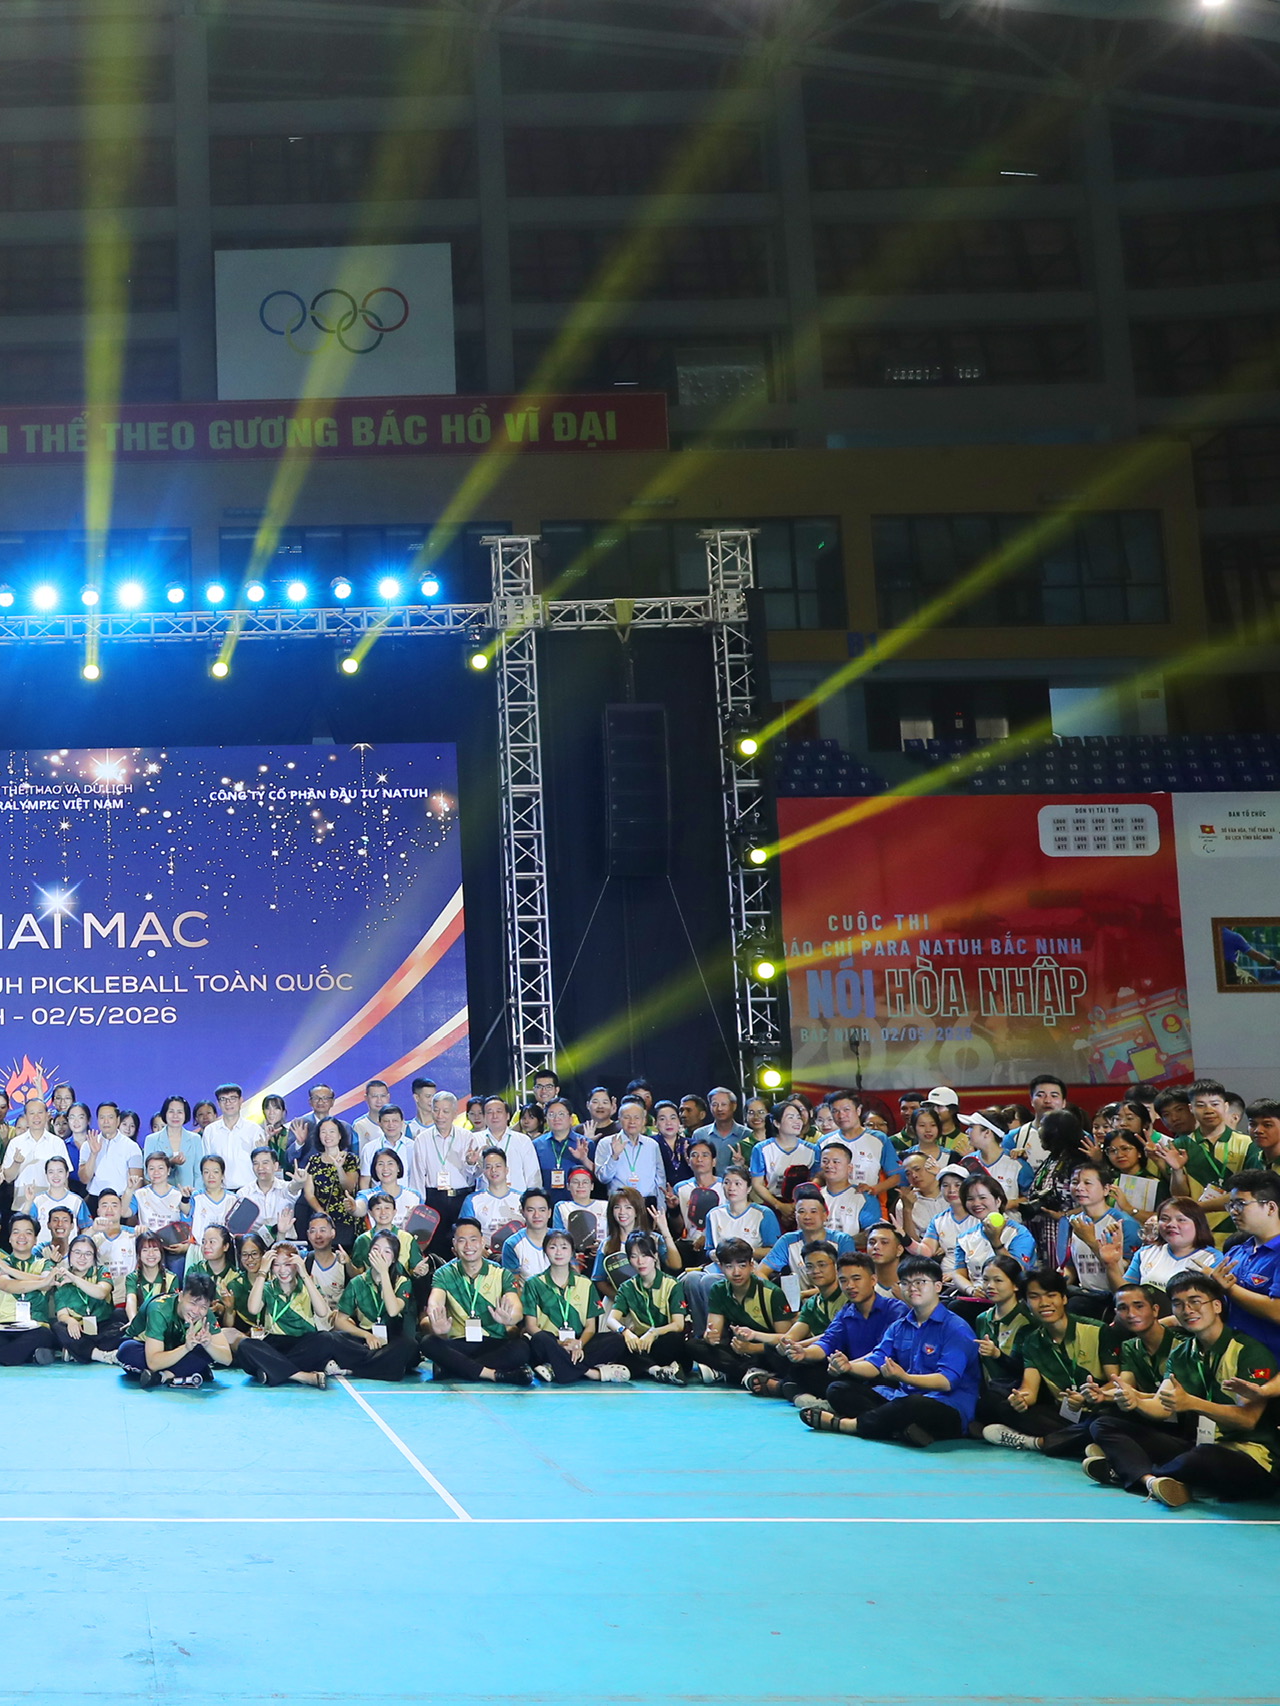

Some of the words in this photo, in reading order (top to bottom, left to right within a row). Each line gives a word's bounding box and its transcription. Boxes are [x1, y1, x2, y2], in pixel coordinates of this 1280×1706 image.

[21, 411, 88, 454] THỂ
[101, 421, 194, 453] THEO
[209, 416, 339, 450] GƯƠNG
[352, 408, 427, 447] BÁC
[441, 403, 492, 445] HỒ
[505, 406, 540, 443] VĨ
[553, 410, 617, 449] ĐẠI
[29, 785, 62, 795] THAO
[64, 783, 80, 795] VÀ
[209, 789, 247, 801] CÔNG
[249, 790, 265, 801] TY
[290, 787, 326, 800] PHẦN
[329, 786, 357, 799] ĐẦU
[360, 788, 380, 799] TƯ
[382, 787, 429, 799] NATUH
[62, 797, 90, 811] VIỆT
[93, 799, 124, 809] NAM
[83, 910, 209, 958] MẠC
[828, 911, 883, 935] CUỘC
[895, 914, 929, 931] THI
[822, 937, 852, 957] CHÍ
[862, 939, 911, 956] PARA
[920, 939, 982, 956] NATUH
[991, 931, 1027, 955] BẮC
[1036, 938, 1082, 955] NINH
[31, 975, 188, 994] PICKLEBALL
[194, 970, 267, 992] TOÀN
[275, 964, 354, 992] QUỐC
[806, 957, 876, 1019] NÓI
[885, 955, 969, 1018] HÒA
[978, 955, 1087, 1027] NHẬP
[31, 1005, 178, 1027] 02/5/2026
